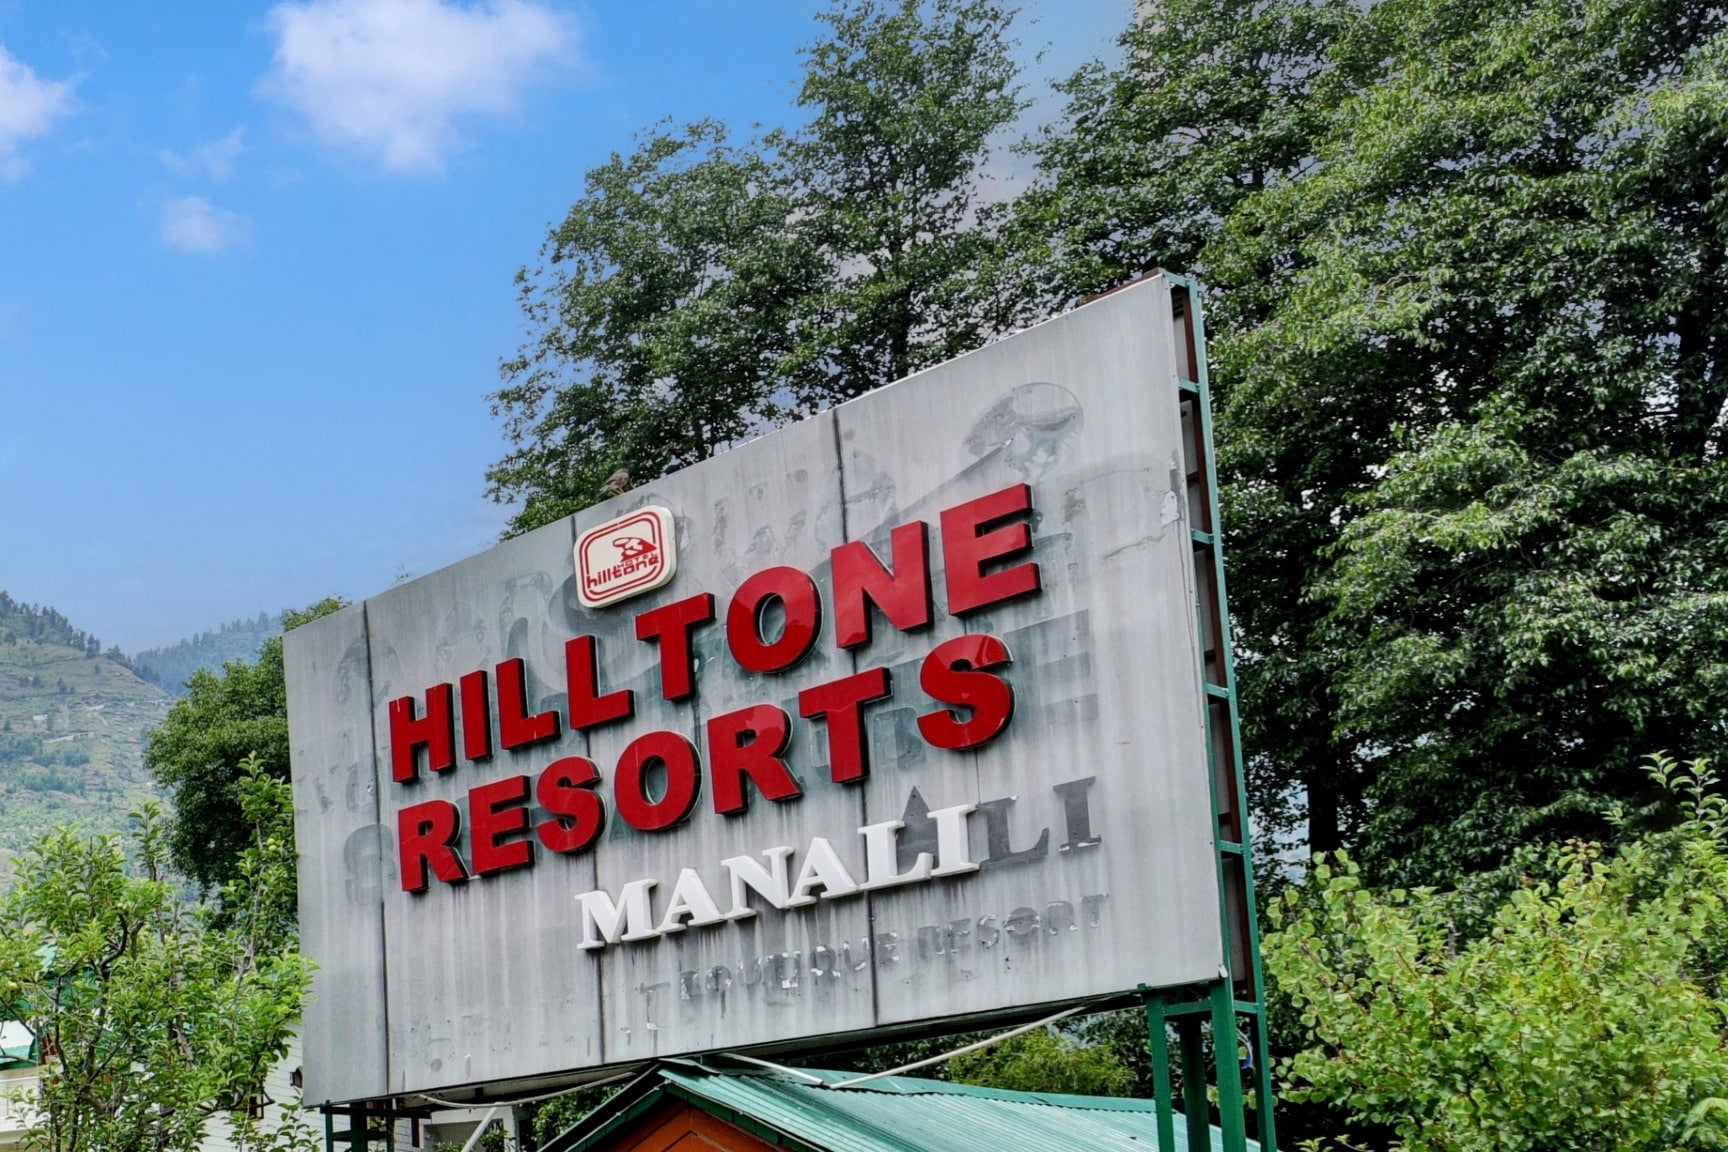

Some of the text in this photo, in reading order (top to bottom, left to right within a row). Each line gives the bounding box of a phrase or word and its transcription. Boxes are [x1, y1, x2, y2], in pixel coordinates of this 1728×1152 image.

[388, 482, 1044, 783] HILLTONE
[586, 556, 659, 589] hilltone
[397, 632, 1016, 892] RESORTS
[574, 802, 982, 950] MANALI
